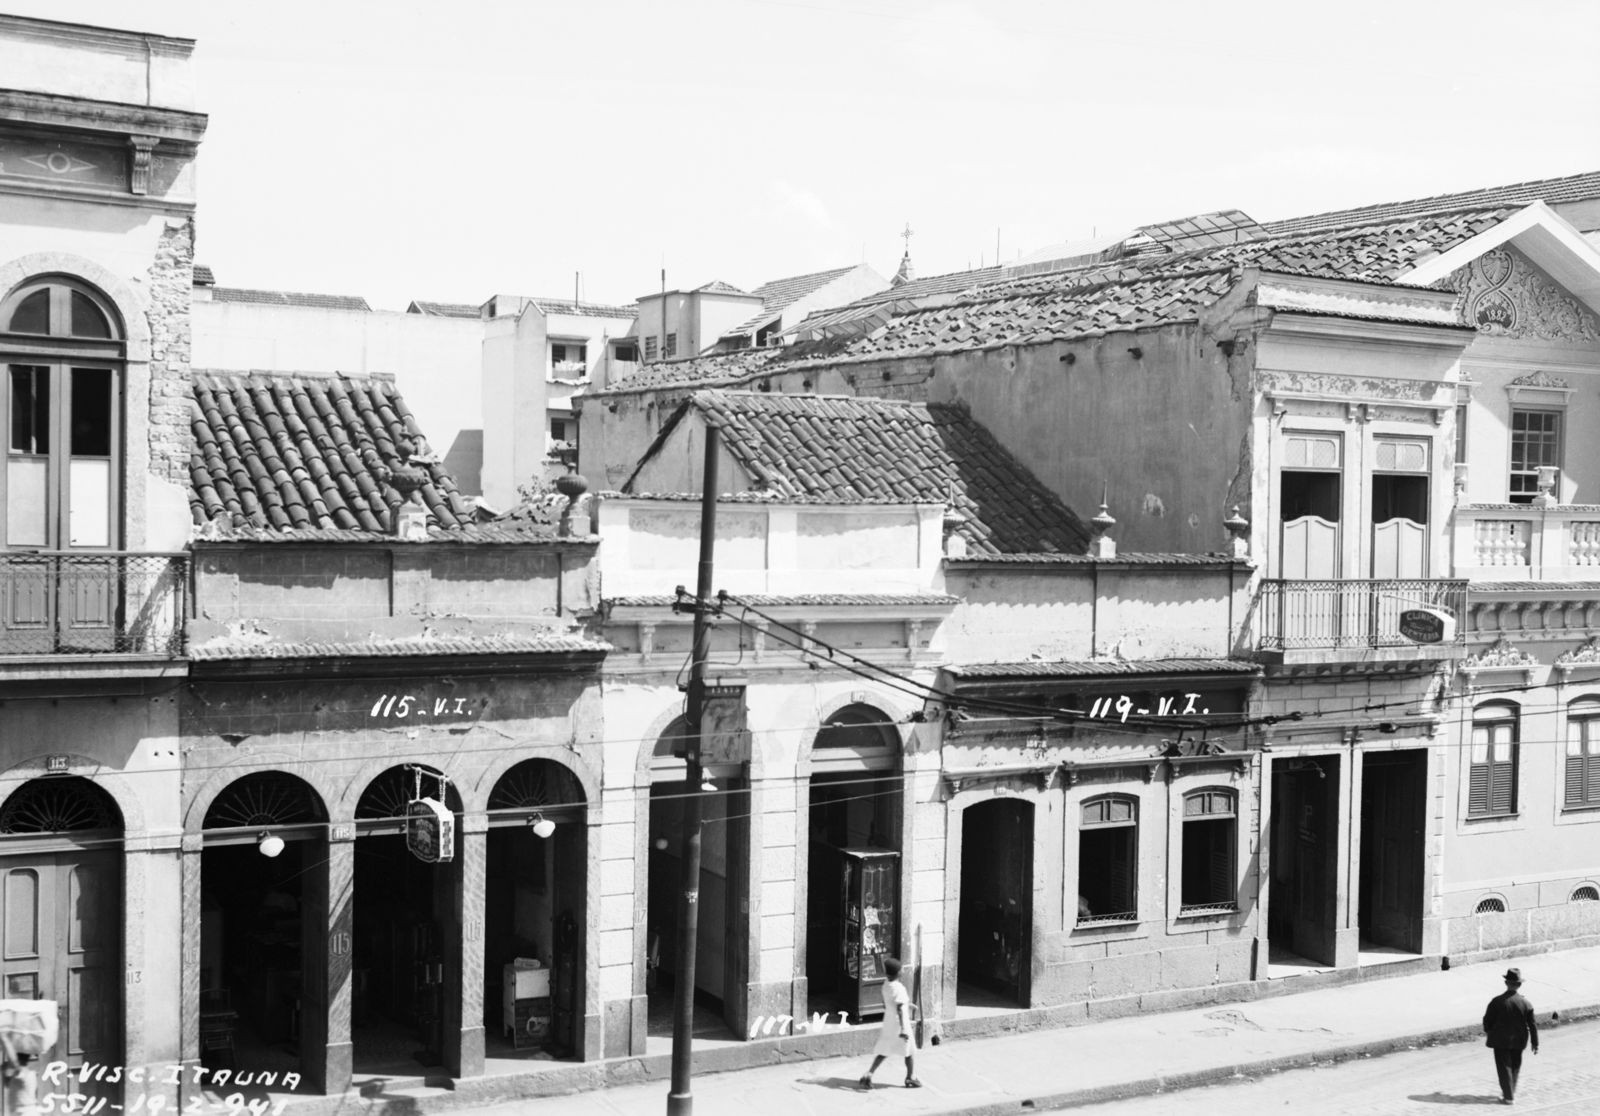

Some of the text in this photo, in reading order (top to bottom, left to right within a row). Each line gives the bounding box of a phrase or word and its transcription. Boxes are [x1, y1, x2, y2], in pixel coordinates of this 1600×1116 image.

[1486, 309, 1506, 322] 1882
[51, 758, 66, 769] 113
[333, 932, 350, 955] 115
[127, 970, 141, 984] 113
